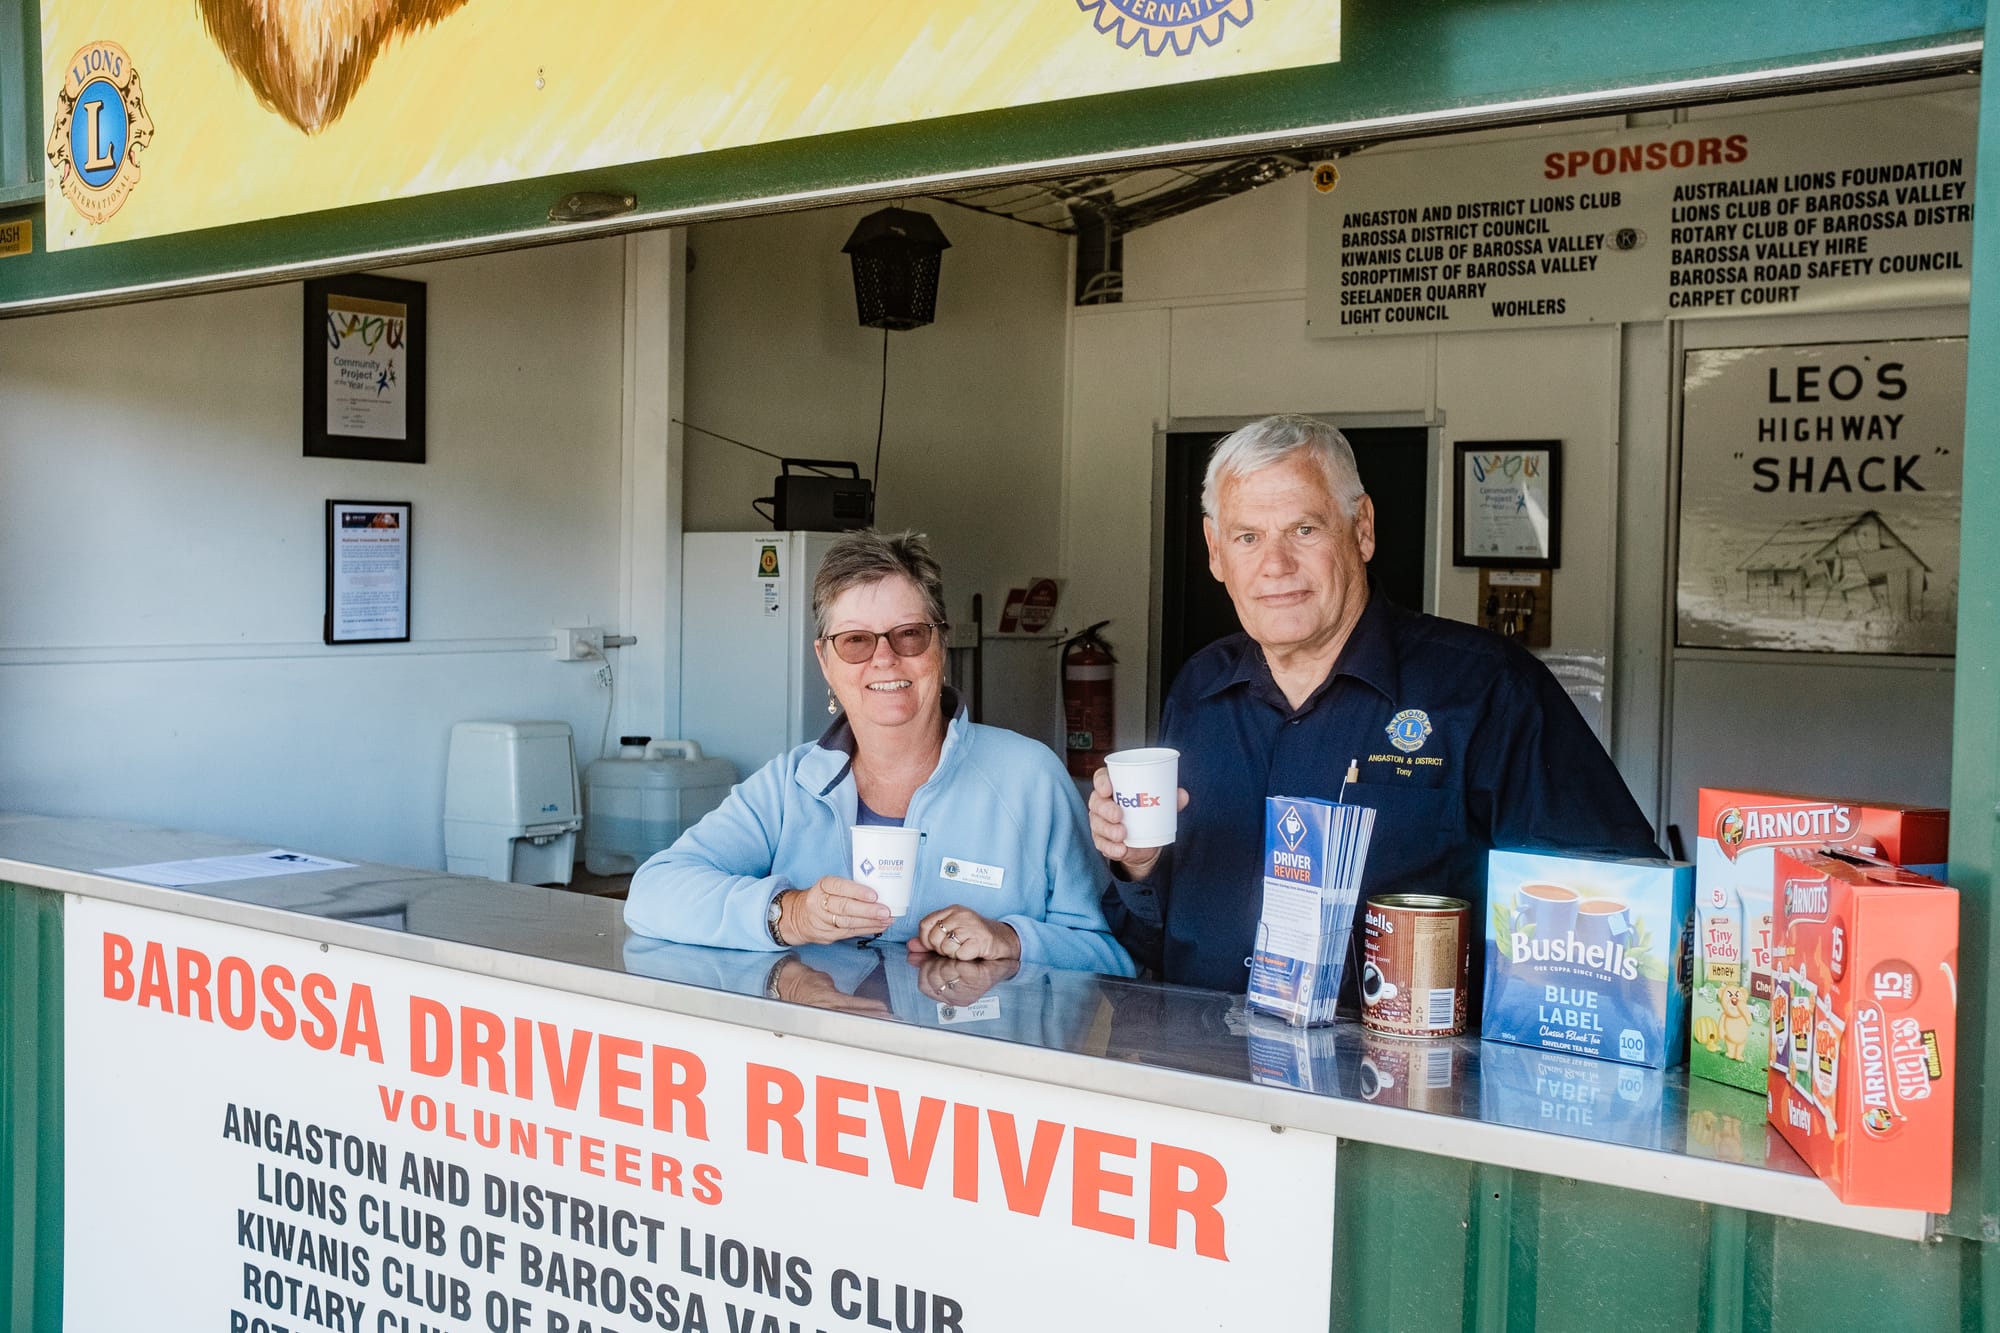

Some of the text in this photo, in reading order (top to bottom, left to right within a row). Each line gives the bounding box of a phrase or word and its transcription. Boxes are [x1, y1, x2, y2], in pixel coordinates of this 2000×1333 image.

[73, 49, 123, 86] LIONS
[1544, 134, 1748, 179] SPONSORS
[68, 174, 130, 211] INTERNATIONAL
[1674, 159, 1962, 202] AUSTRALIAN LIONS FOUNDATION
[1343, 192, 1621, 228] ANGASTON AND DISTRICT LIONS CLUB
[1672, 182, 1966, 223] LIONS CLUB OF BAROSSA VALLEY
[1342, 219, 1549, 248] BAROSSA DISTRICT COUNCIL
[1671, 224, 1737, 244] ROTARY
[1743, 220, 1788, 239] CLUB
[1794, 218, 1817, 235] OF
[1823, 210, 1908, 233] BAROSSA
[1342, 234, 1605, 267] KIWANIS CLUB OF BAROSSA VALLEY
[1672, 237, 1868, 265] BAROSSA VALLEY HIRE
[1341, 256, 1598, 286] SOROPTIMIST OF BAROSSA VALLEY
[1670, 252, 1962, 286] BAROSSA ROAD SAFETY COUNCIL
[1341, 284, 1486, 305] SEELANDER QUARRY
[1669, 286, 1800, 308] CARPET COURT
[1341, 299, 1565, 325] LIGHT COUNCIL WOHLERS
[334, 357, 380, 371] Community
[341, 368, 372, 380] Project
[1758, 414, 1904, 442] HIGHWAY
[1400, 711, 1425, 720] LIONS
[1368, 754, 1443, 766] ANGASTON & DISTRICT
[1396, 767, 1412, 776] Tony
[1116, 792, 1160, 808] FedEx
[1745, 803, 1850, 839] ARNOTT'S
[1274, 851, 1311, 870] DRIVER
[1274, 865, 1311, 882] REVIVER
[1791, 884, 1828, 914] ARNOTT'S
[1708, 928, 1732, 944] Tiny
[1832, 926, 1844, 962] 15
[1511, 931, 1638, 980] Bushells
[1705, 943, 1738, 961] Teddy
[1573, 968, 1593, 977] SINCE
[1712, 965, 1734, 978] Honey
[1874, 971, 1902, 1000] 15
[1545, 985, 1598, 1009] BLUE
[1539, 1005, 1604, 1032] LABEL
[1539, 1025, 1564, 1039] Classic
[1565, 1030, 1588, 1043] Black
[1542, 1040, 1571, 1050] ENVELOPE
[1572, 1045, 1583, 1053] TEA
[1621, 1036, 1644, 1051] 100
[1858, 1008, 1887, 1107] ARNOTT'S
[103, 931, 1229, 1262] BAROSSA DRIVER REVIVER
[1788, 1098, 1811, 1137] Variety
[378, 1085, 723, 1206] VOLUNTEERS
[222, 1102, 964, 1333] ANGASTON AND DISTRICT LIONS CLUB
[257, 1162, 347, 1226] LIONS
[358, 1194, 447, 1257] CLUB
[460, 1225, 506, 1275] OF
[520, 1241, 709, 1333] BAROSSA
[237, 1208, 532, 1333] KIWANIS CLUB OF
[243, 1262, 366, 1333] ROTARY
